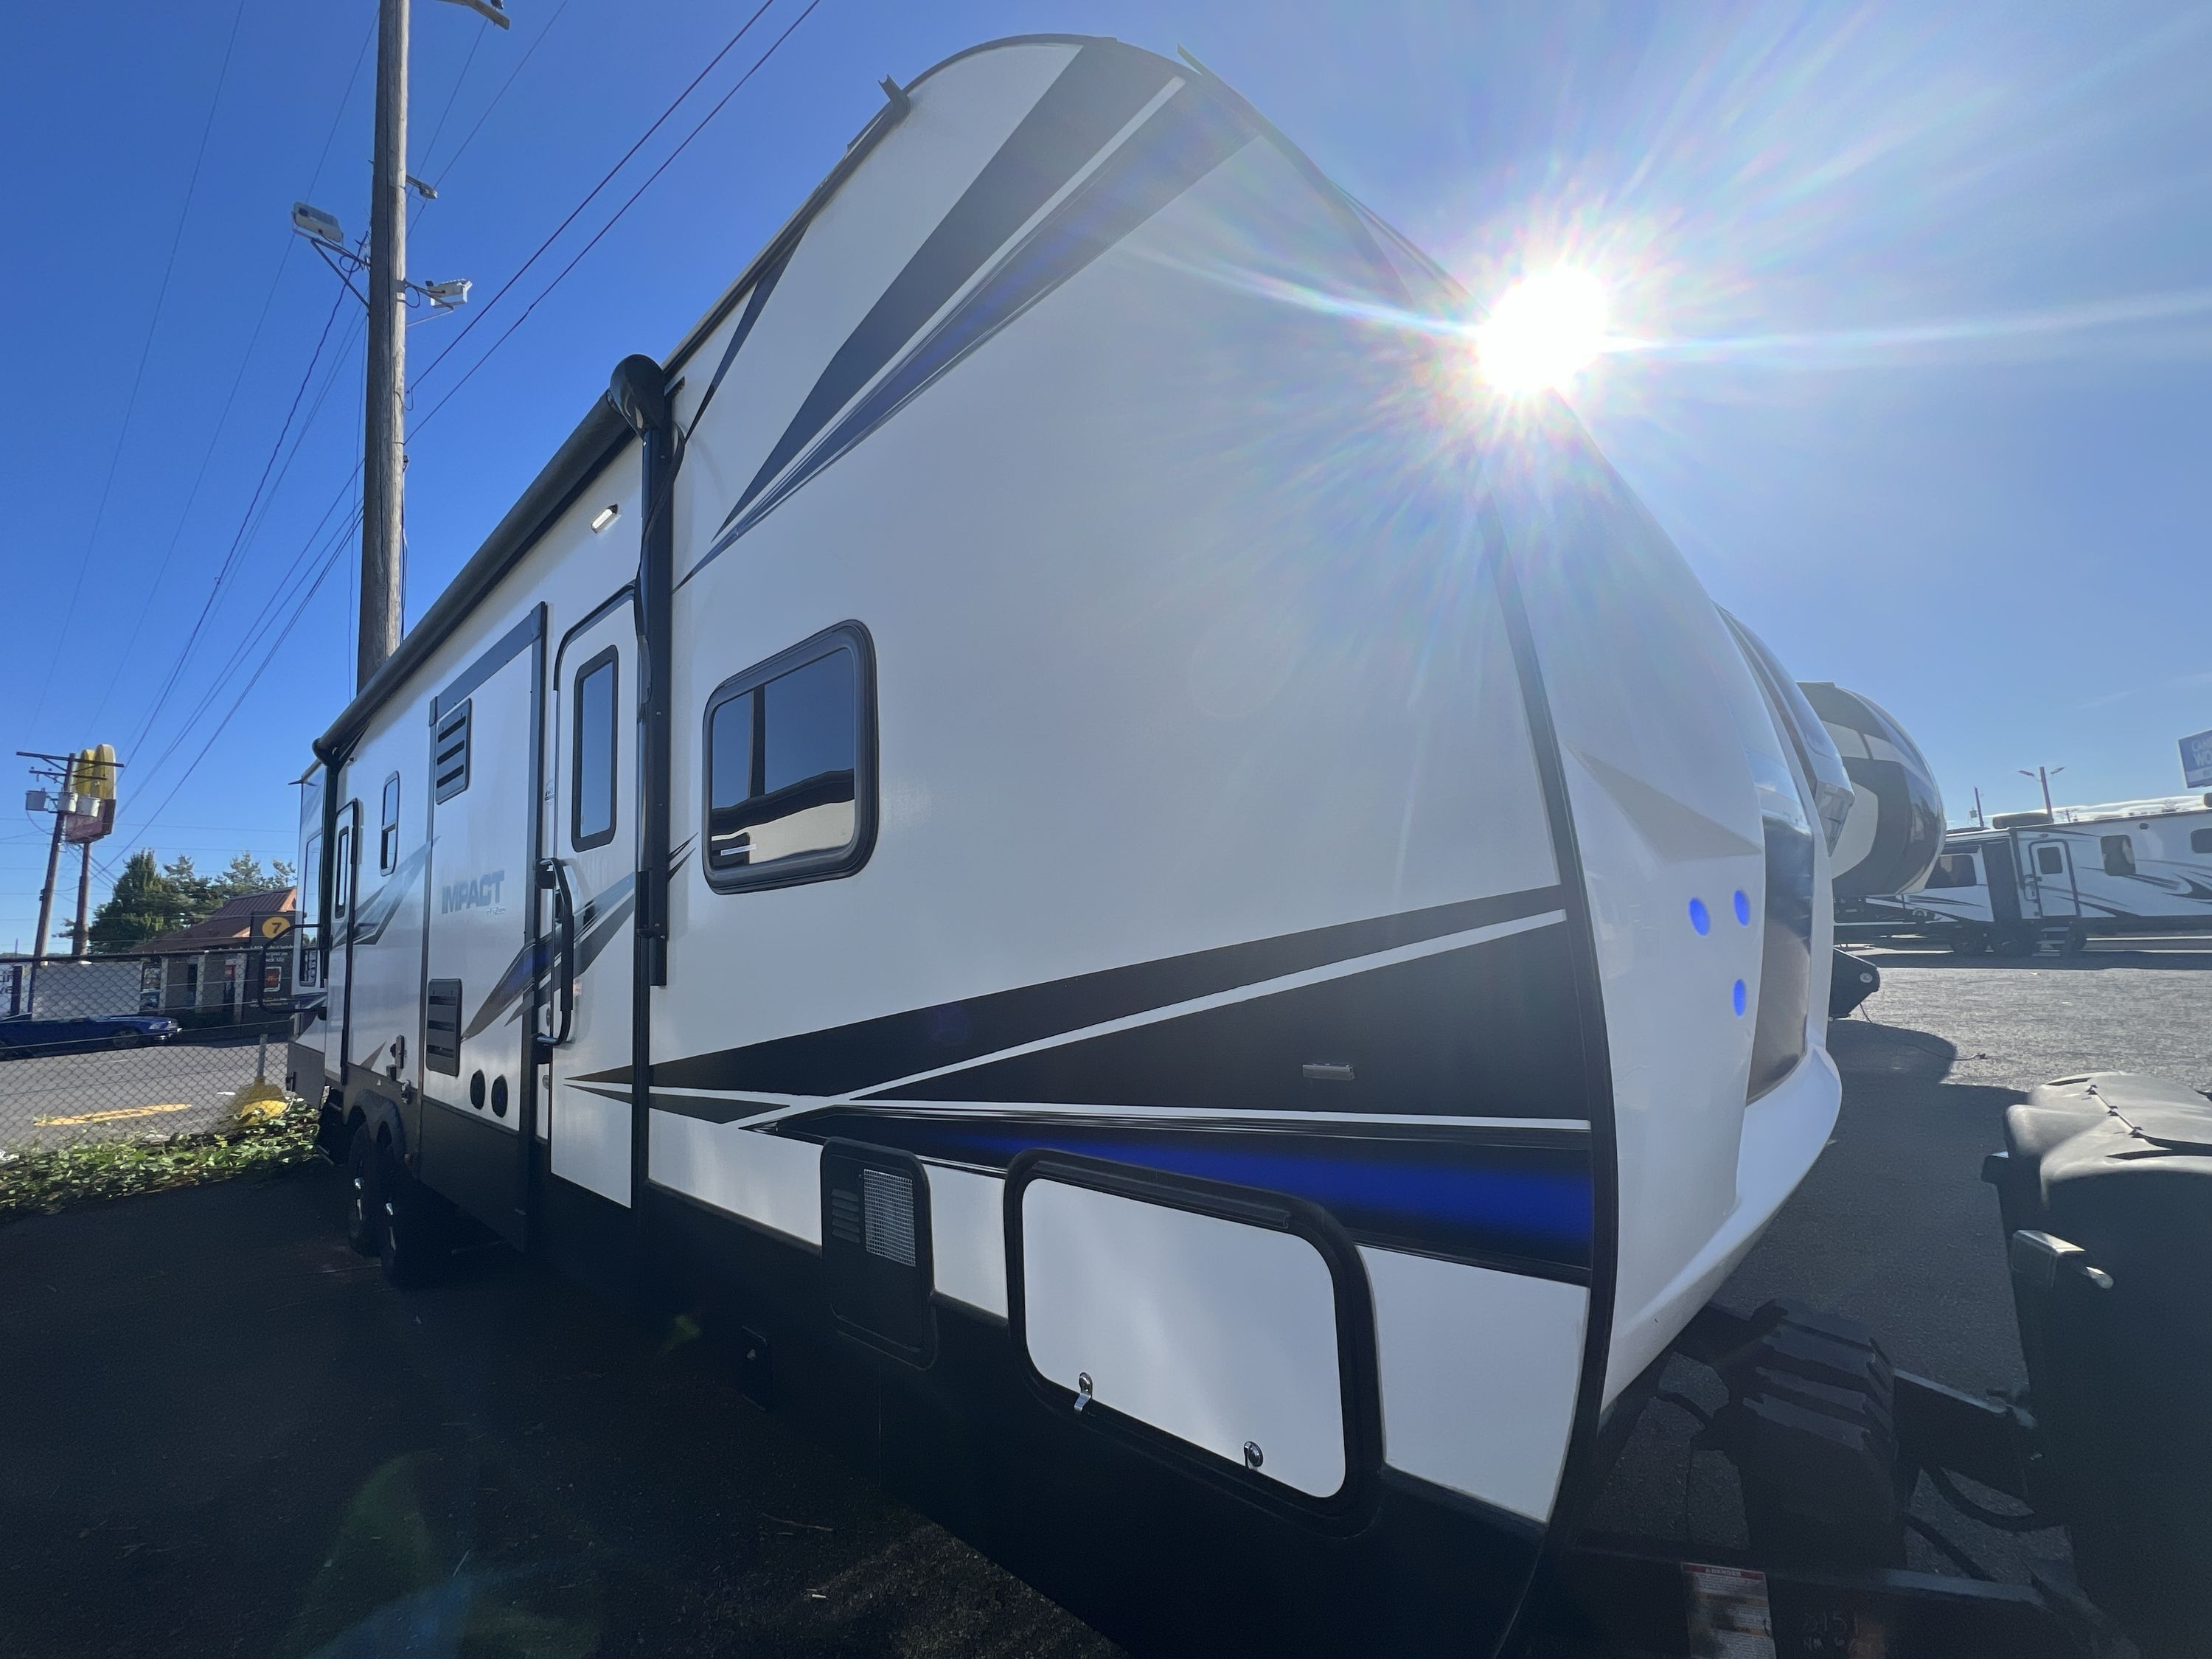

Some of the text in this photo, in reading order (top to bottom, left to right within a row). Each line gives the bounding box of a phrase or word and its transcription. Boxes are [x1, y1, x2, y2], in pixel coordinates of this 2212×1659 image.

[442, 869, 504, 915] IMPACT
[271, 922, 282, 933] 7
[1711, 1568, 1742, 1578] DANGER
